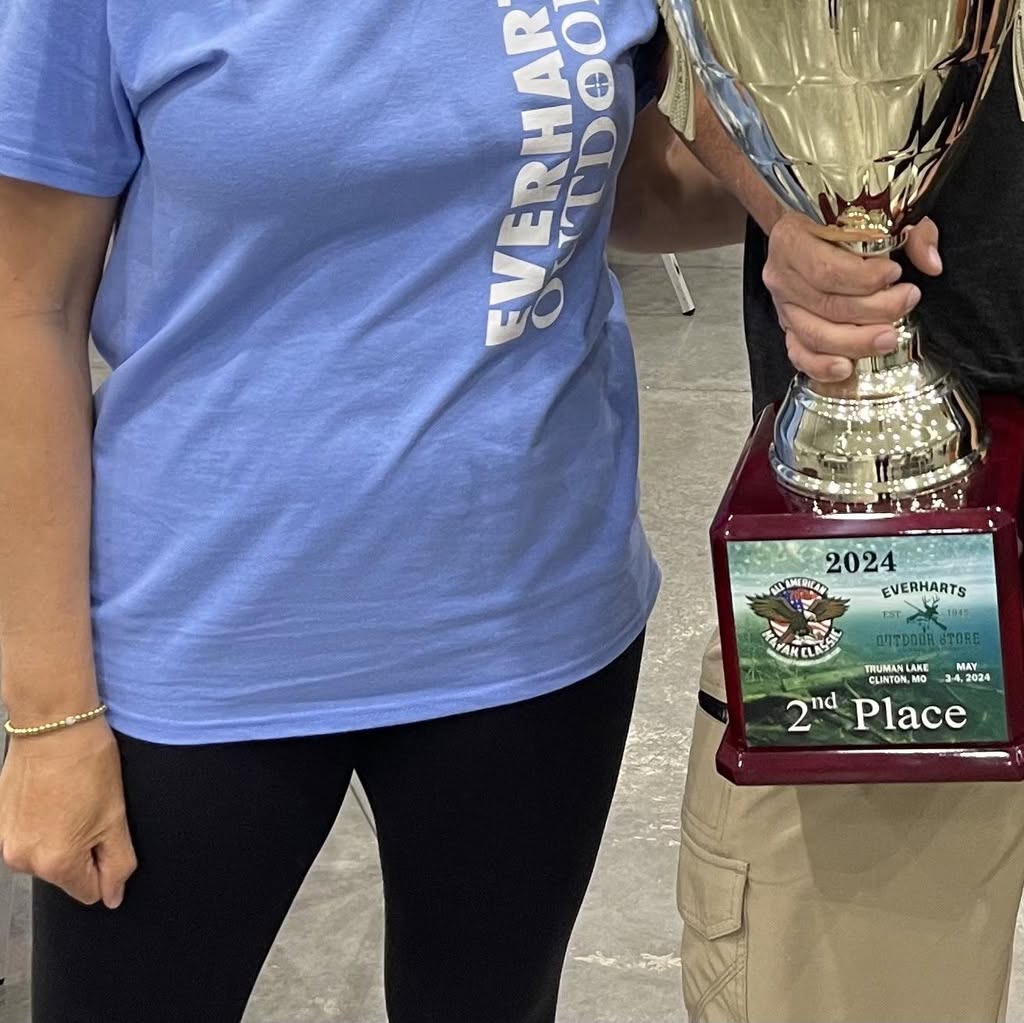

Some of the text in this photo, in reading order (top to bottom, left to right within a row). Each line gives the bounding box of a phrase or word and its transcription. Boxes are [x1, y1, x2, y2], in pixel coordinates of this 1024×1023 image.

[825, 550, 897, 574] 2024
[769, 578, 827, 596] ALL AMERICAN
[881, 581, 967, 599] EVERHARTS
[761, 629, 799, 657] KAYAK
[801, 628, 842, 658] CLASSIC
[876, 632, 981, 647] OUTDOOR STORE
[864, 663, 929, 673] TRUMAN LAKE
[956, 662, 978, 671] MAY
[868, 674, 927, 685] CLINTON, MO
[965, 673, 991, 682] 2024
[785, 691, 967, 733] 2nd Place
